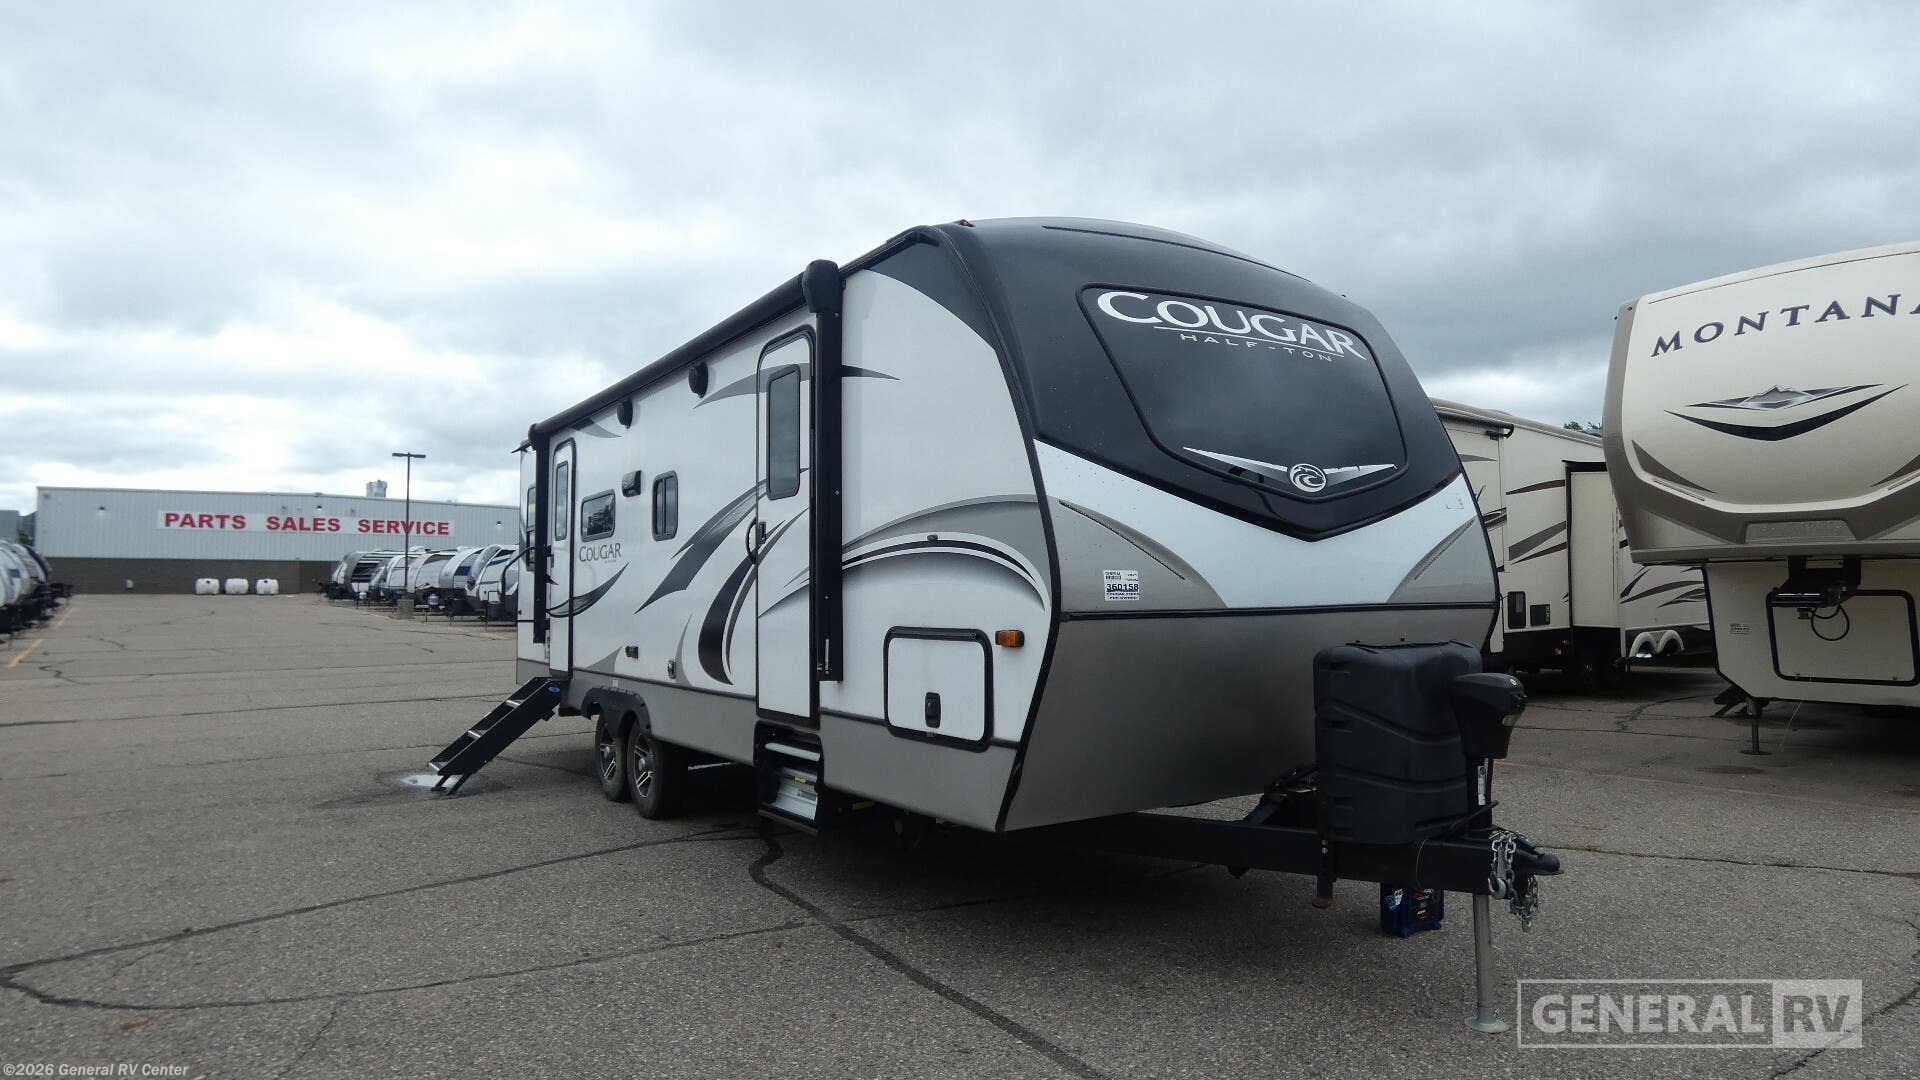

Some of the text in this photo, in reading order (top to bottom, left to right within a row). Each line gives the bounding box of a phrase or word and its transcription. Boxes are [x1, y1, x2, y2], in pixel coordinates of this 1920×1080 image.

[1097, 291, 1367, 361] COUGAR
[1651, 294, 1920, 357] MONTAN
[165, 513, 449, 535] PARTS SALES SERVICE
[579, 543, 621, 562] COUGAR
[1106, 583, 1139, 592] 360158
